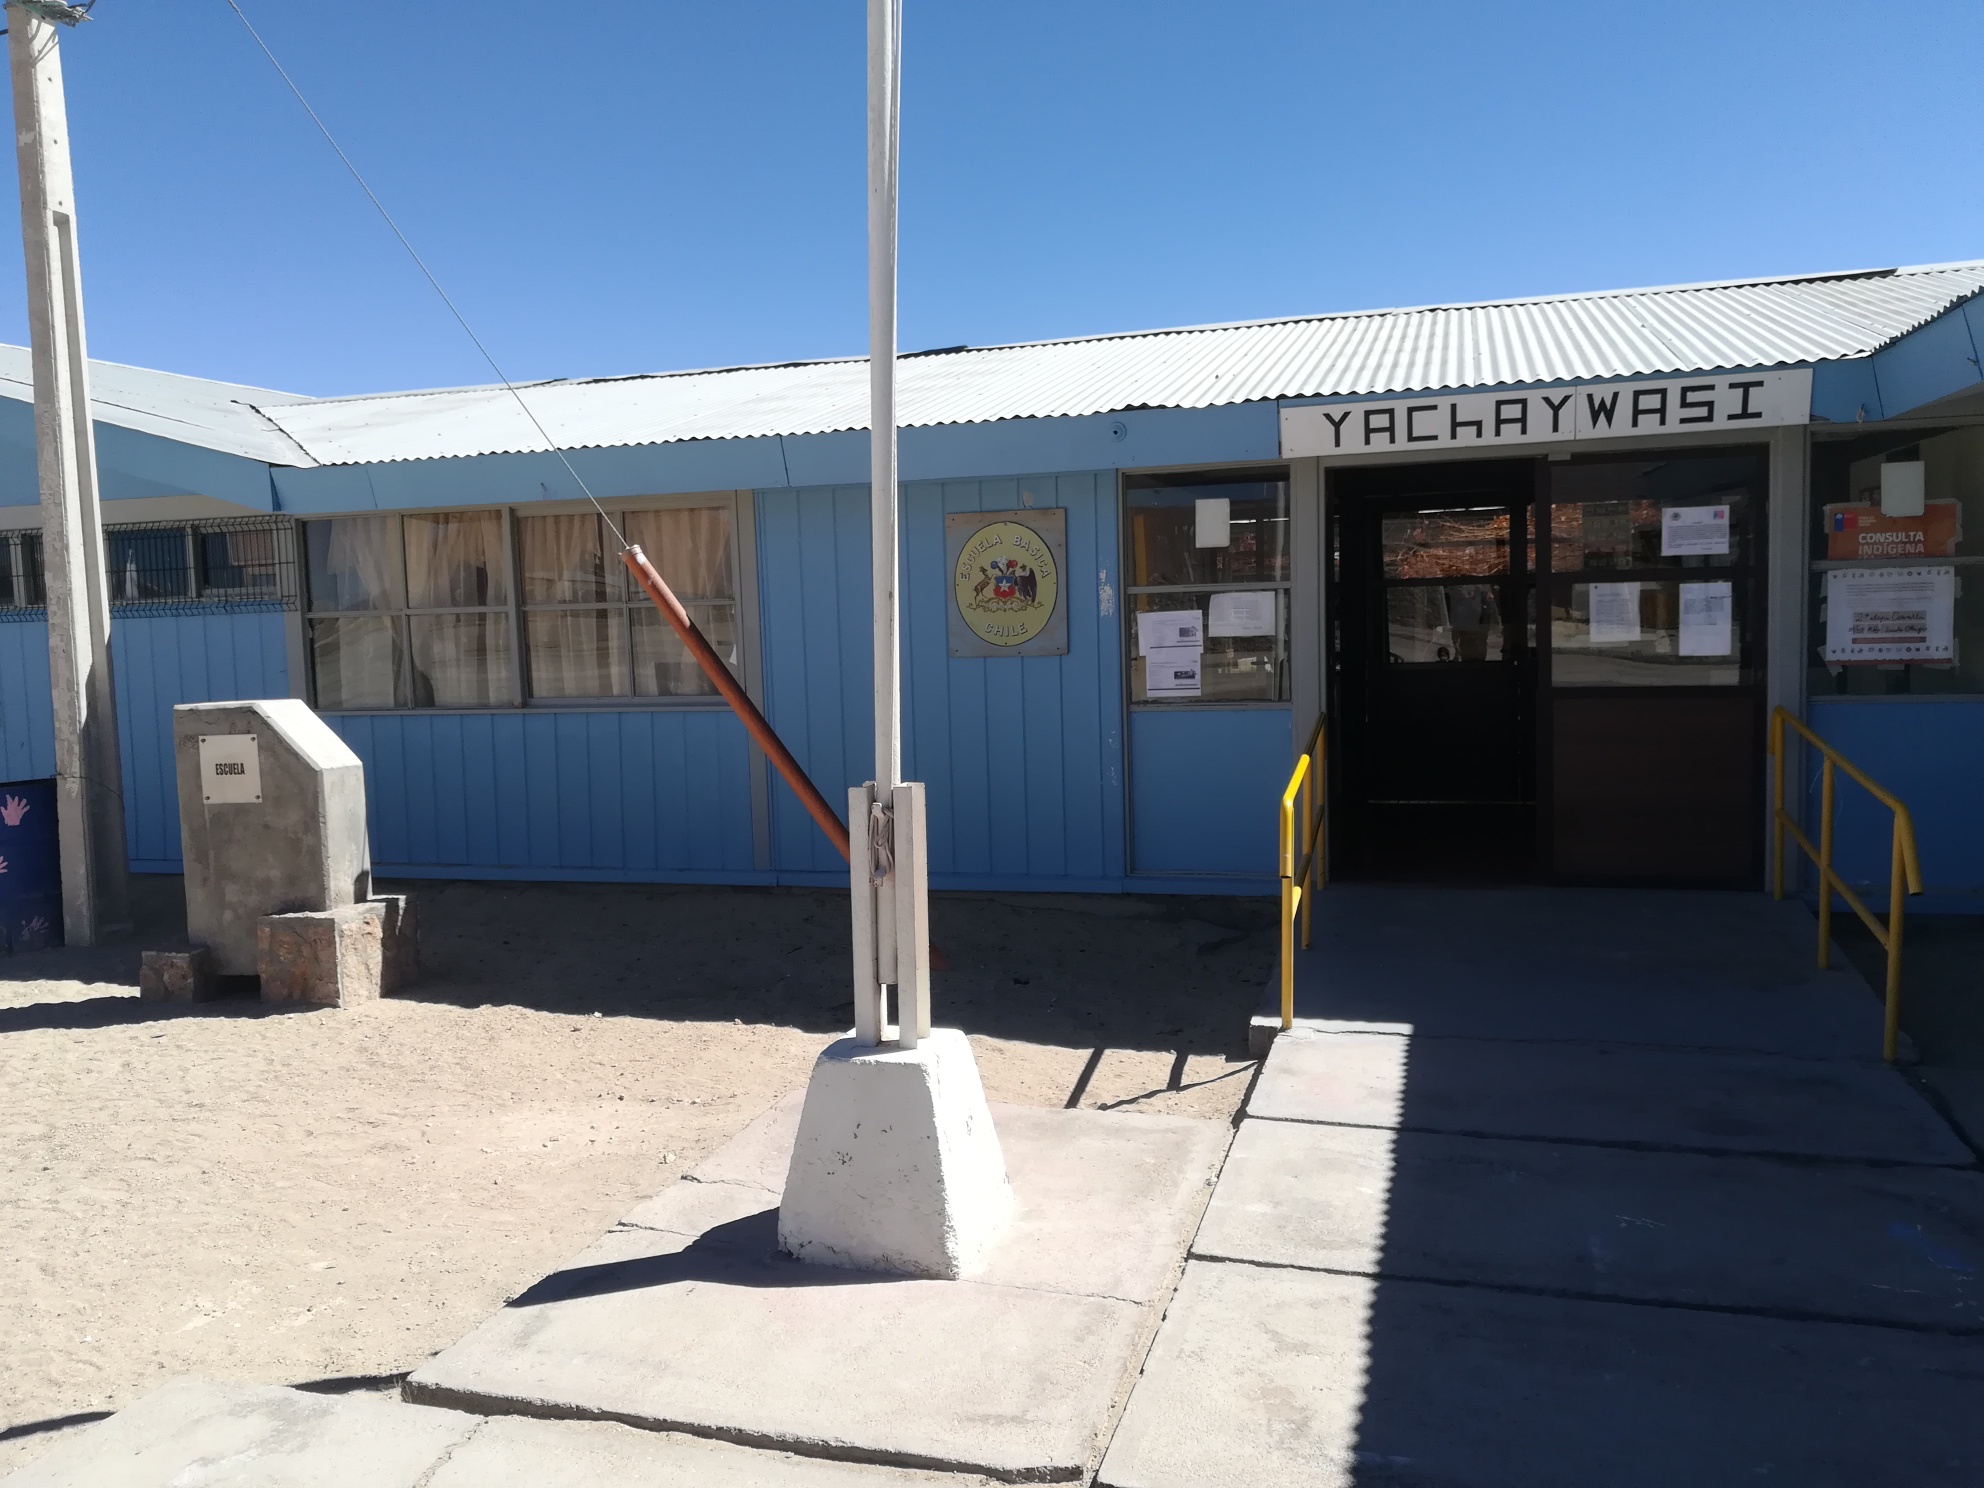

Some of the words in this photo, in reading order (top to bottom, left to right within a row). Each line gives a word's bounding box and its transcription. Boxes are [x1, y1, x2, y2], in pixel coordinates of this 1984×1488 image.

[1858, 531, 1924, 544] CONSULTA
[1858, 542, 1925, 555] INDÍGENA
[960, 534, 1003, 582] ESCUELA
[1012, 535, 1052, 579] BASICA
[984, 622, 1028, 637] CHILE
[215, 762, 245, 776] ESCUELA
